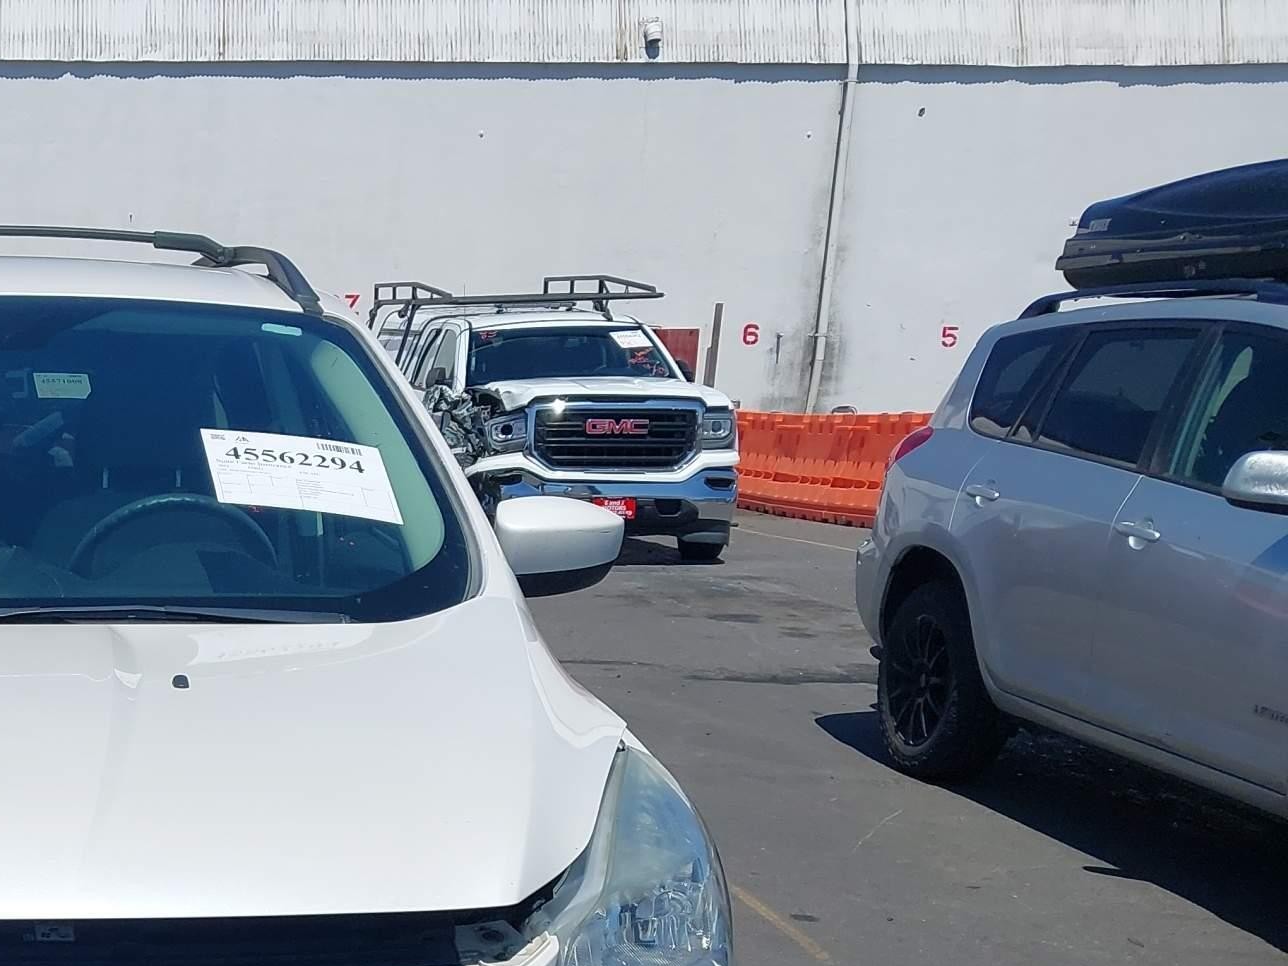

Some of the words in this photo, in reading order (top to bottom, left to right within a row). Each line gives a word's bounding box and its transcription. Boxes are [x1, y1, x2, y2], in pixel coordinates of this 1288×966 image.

[345, 294, 361, 308] 7
[742, 323, 760, 345] 6
[941, 326, 959, 347] 5
[585, 419, 649, 435] GMC
[225, 446, 365, 473] 45562294
